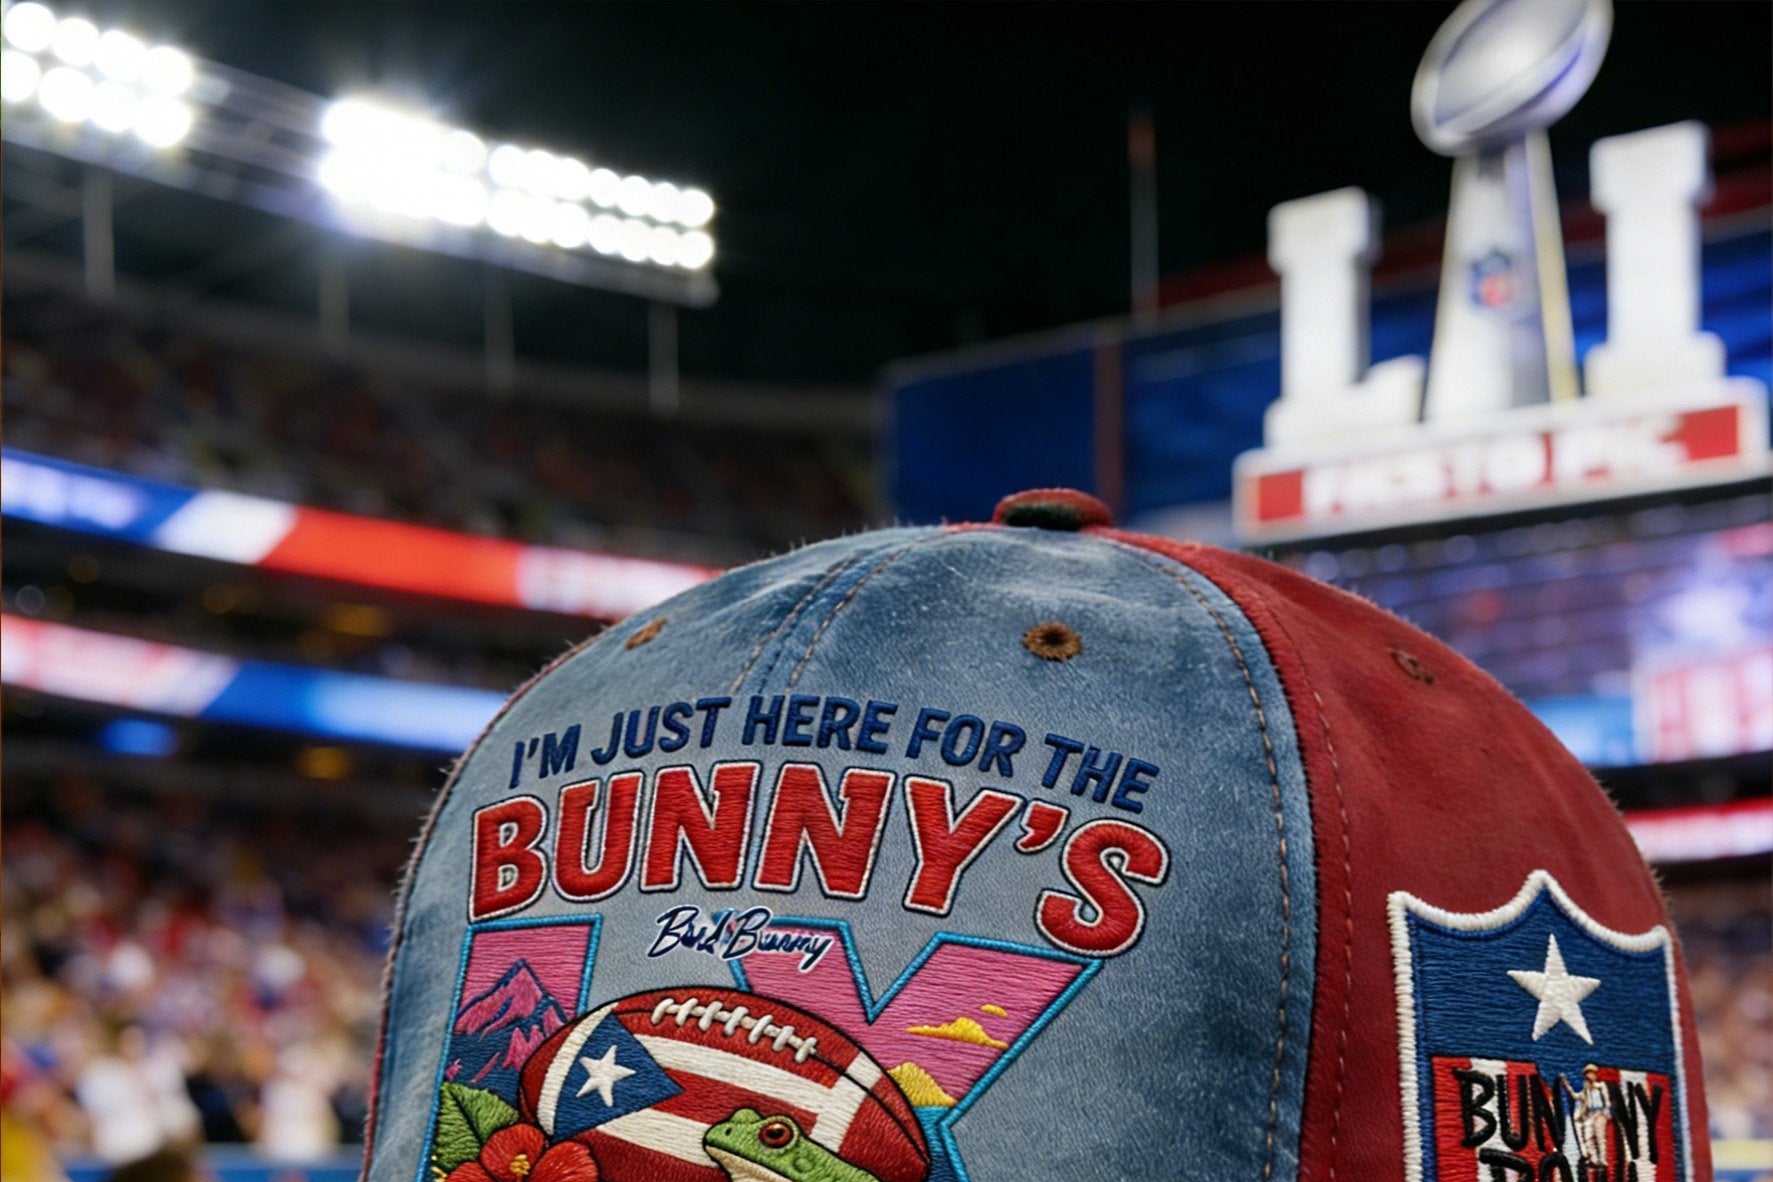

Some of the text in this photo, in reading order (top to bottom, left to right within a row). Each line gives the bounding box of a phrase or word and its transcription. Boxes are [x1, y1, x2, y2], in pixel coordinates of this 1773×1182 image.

[508, 694, 1160, 813] I'M JUST HERE FOR THE
[468, 761, 1170, 957] BUNNY'S
[722, 905, 833, 973] Bunny
[1452, 1067, 1664, 1165] BUNNY
